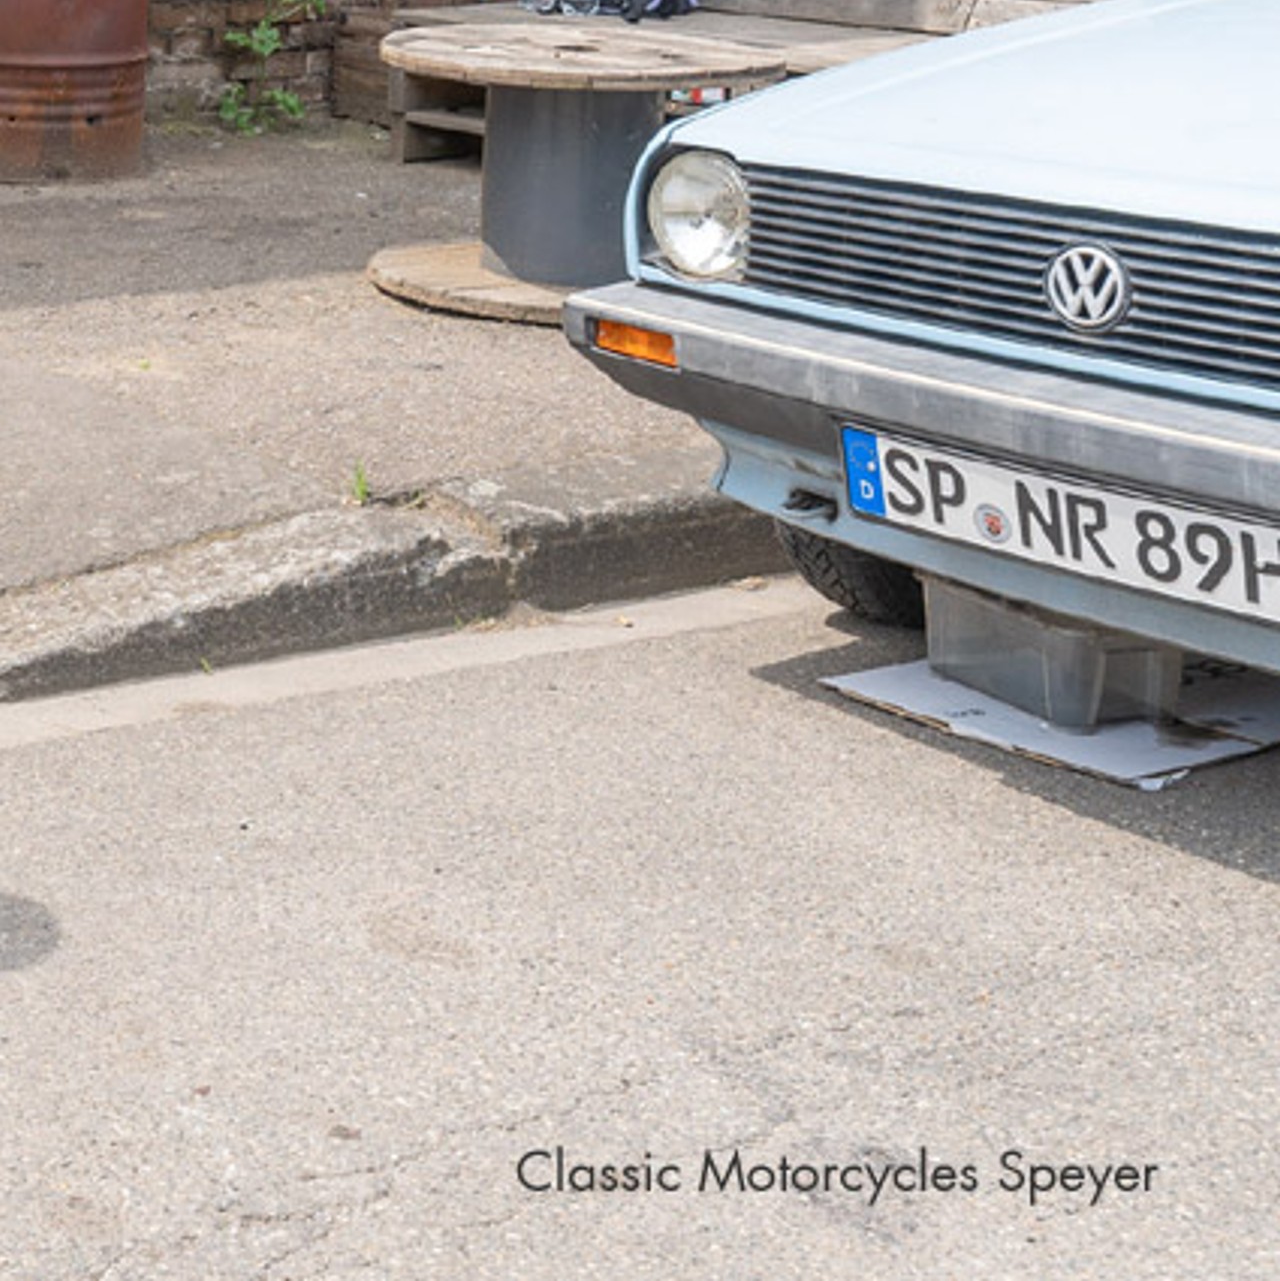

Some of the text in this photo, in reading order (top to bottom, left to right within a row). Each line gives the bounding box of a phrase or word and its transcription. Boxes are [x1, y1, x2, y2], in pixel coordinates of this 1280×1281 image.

[1049, 247, 1126, 326] VW
[858, 480, 875, 500] D
[884, 449, 966, 524] SP
[1015, 480, 1116, 569] NR
